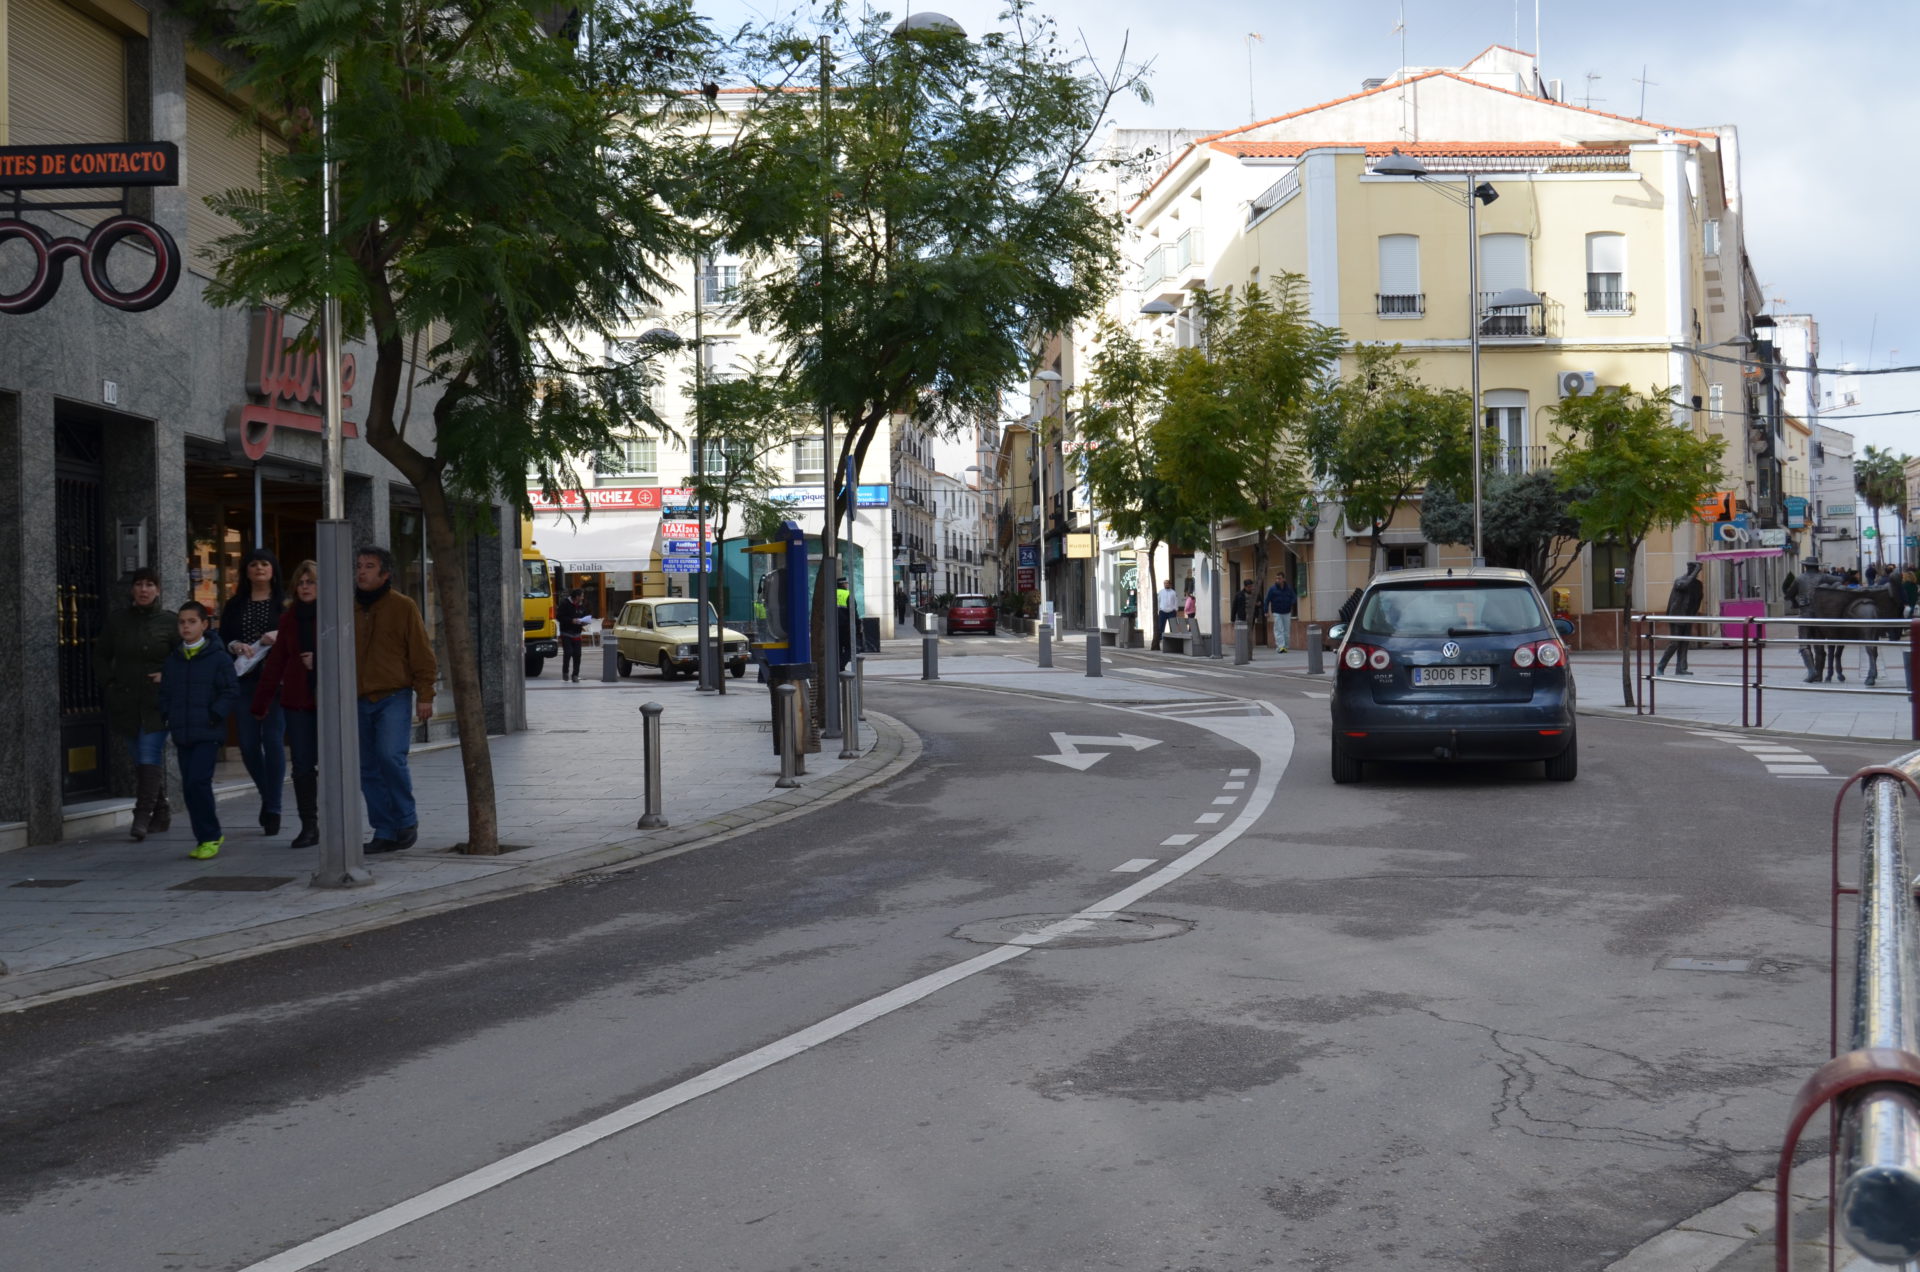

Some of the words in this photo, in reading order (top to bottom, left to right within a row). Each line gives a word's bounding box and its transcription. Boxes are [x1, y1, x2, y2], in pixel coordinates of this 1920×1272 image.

[41, 154, 66, 175] DE
[70, 151, 166, 175] CONTACTO
[663, 523, 685, 533] TAXI
[1021, 551, 1033, 560] 24
[569, 562, 604, 572] Eulalia
[1423, 668, 1455, 681] 3006
[1461, 668, 1487, 681] FSF
